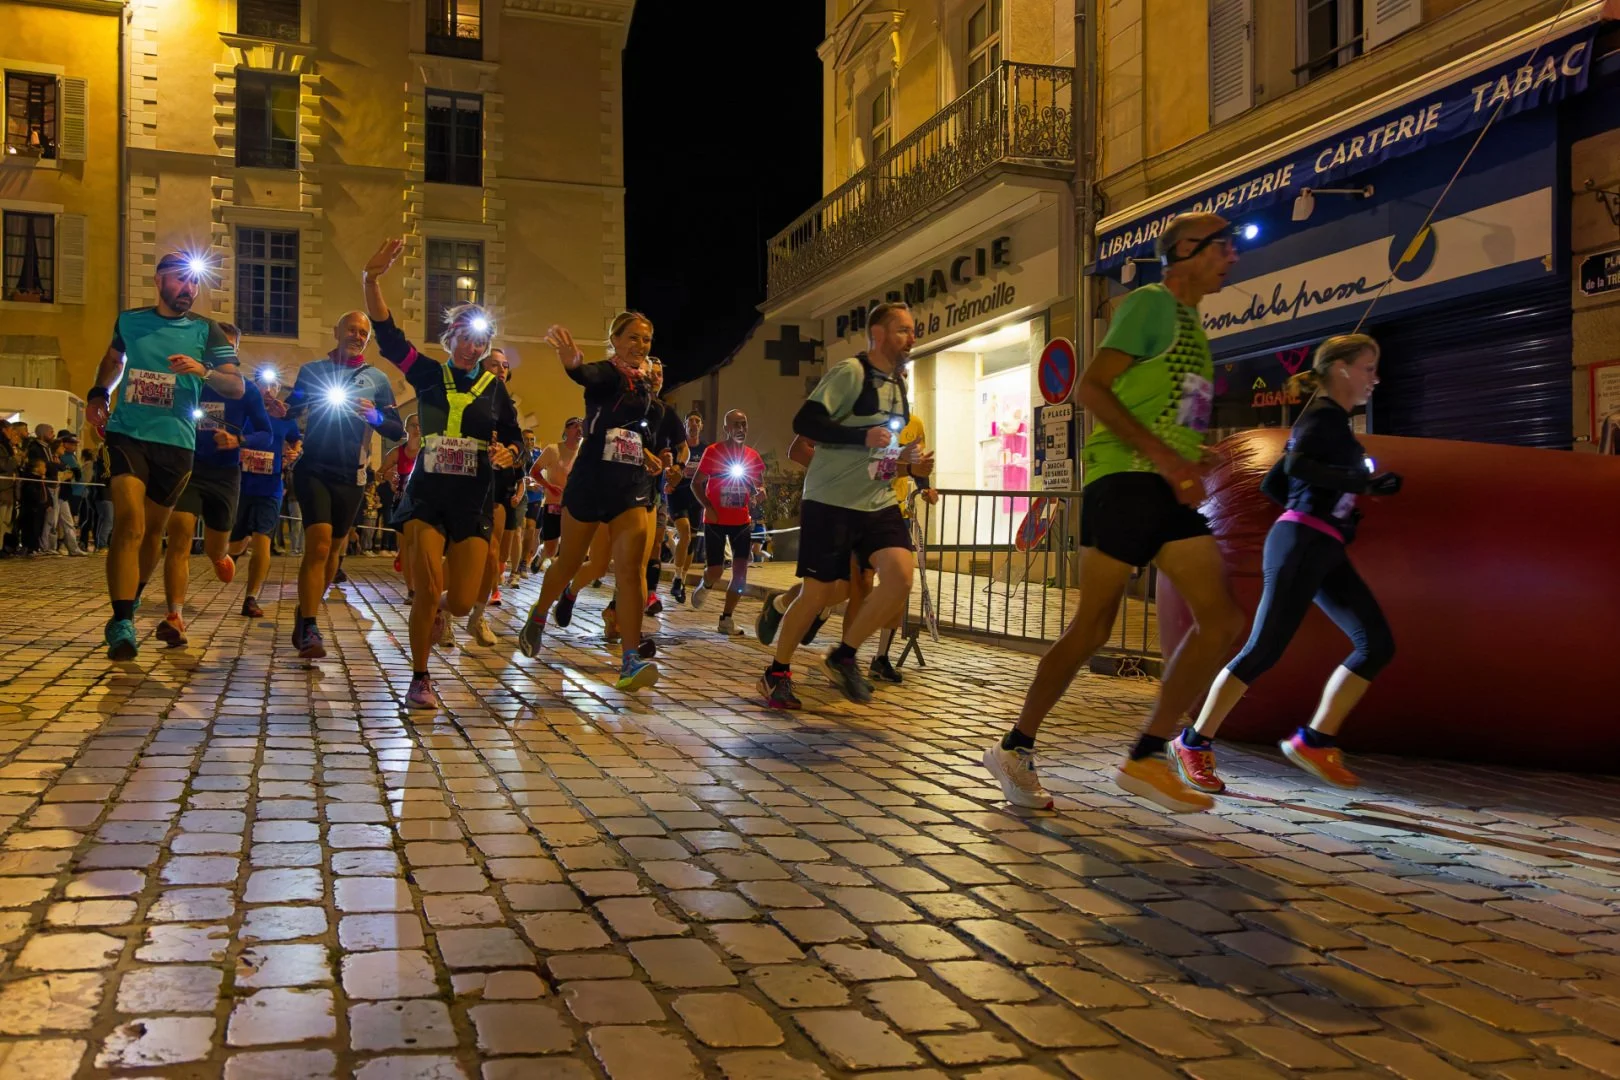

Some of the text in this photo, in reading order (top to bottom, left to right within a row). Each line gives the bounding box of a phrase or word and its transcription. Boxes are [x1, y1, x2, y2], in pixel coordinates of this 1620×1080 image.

[1314, 102, 1442, 173] CARTERIE
[1471, 41, 1587, 113] TABAC
[928, 312, 940, 335] la
[945, 281, 1016, 328] Trémoille
